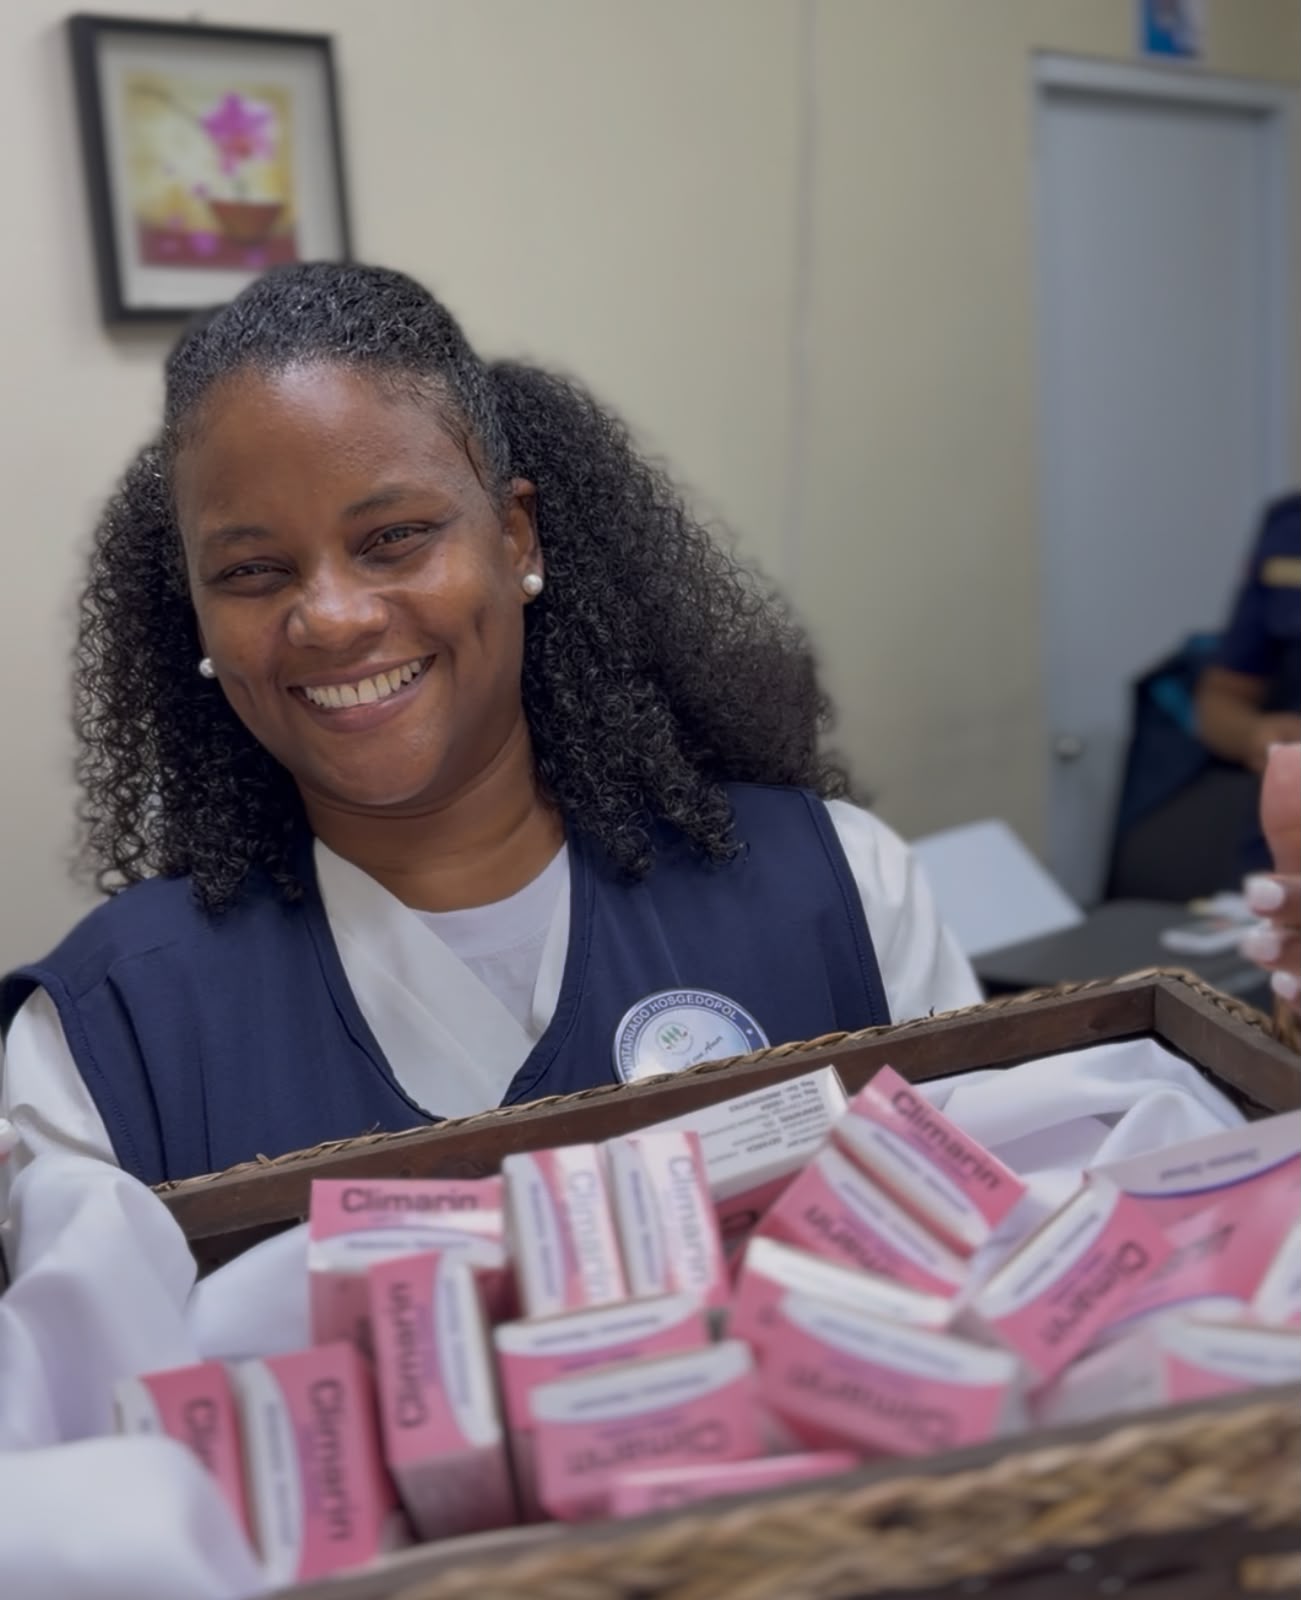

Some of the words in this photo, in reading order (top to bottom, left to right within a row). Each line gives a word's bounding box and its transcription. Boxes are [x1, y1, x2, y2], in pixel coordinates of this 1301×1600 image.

[650, 993, 737, 1020] HOSGEDOPOL
[891, 1089, 1000, 1190] Climarin
[341, 1186, 478, 1214] Climarin
[309, 1377, 352, 1541] Climarin
